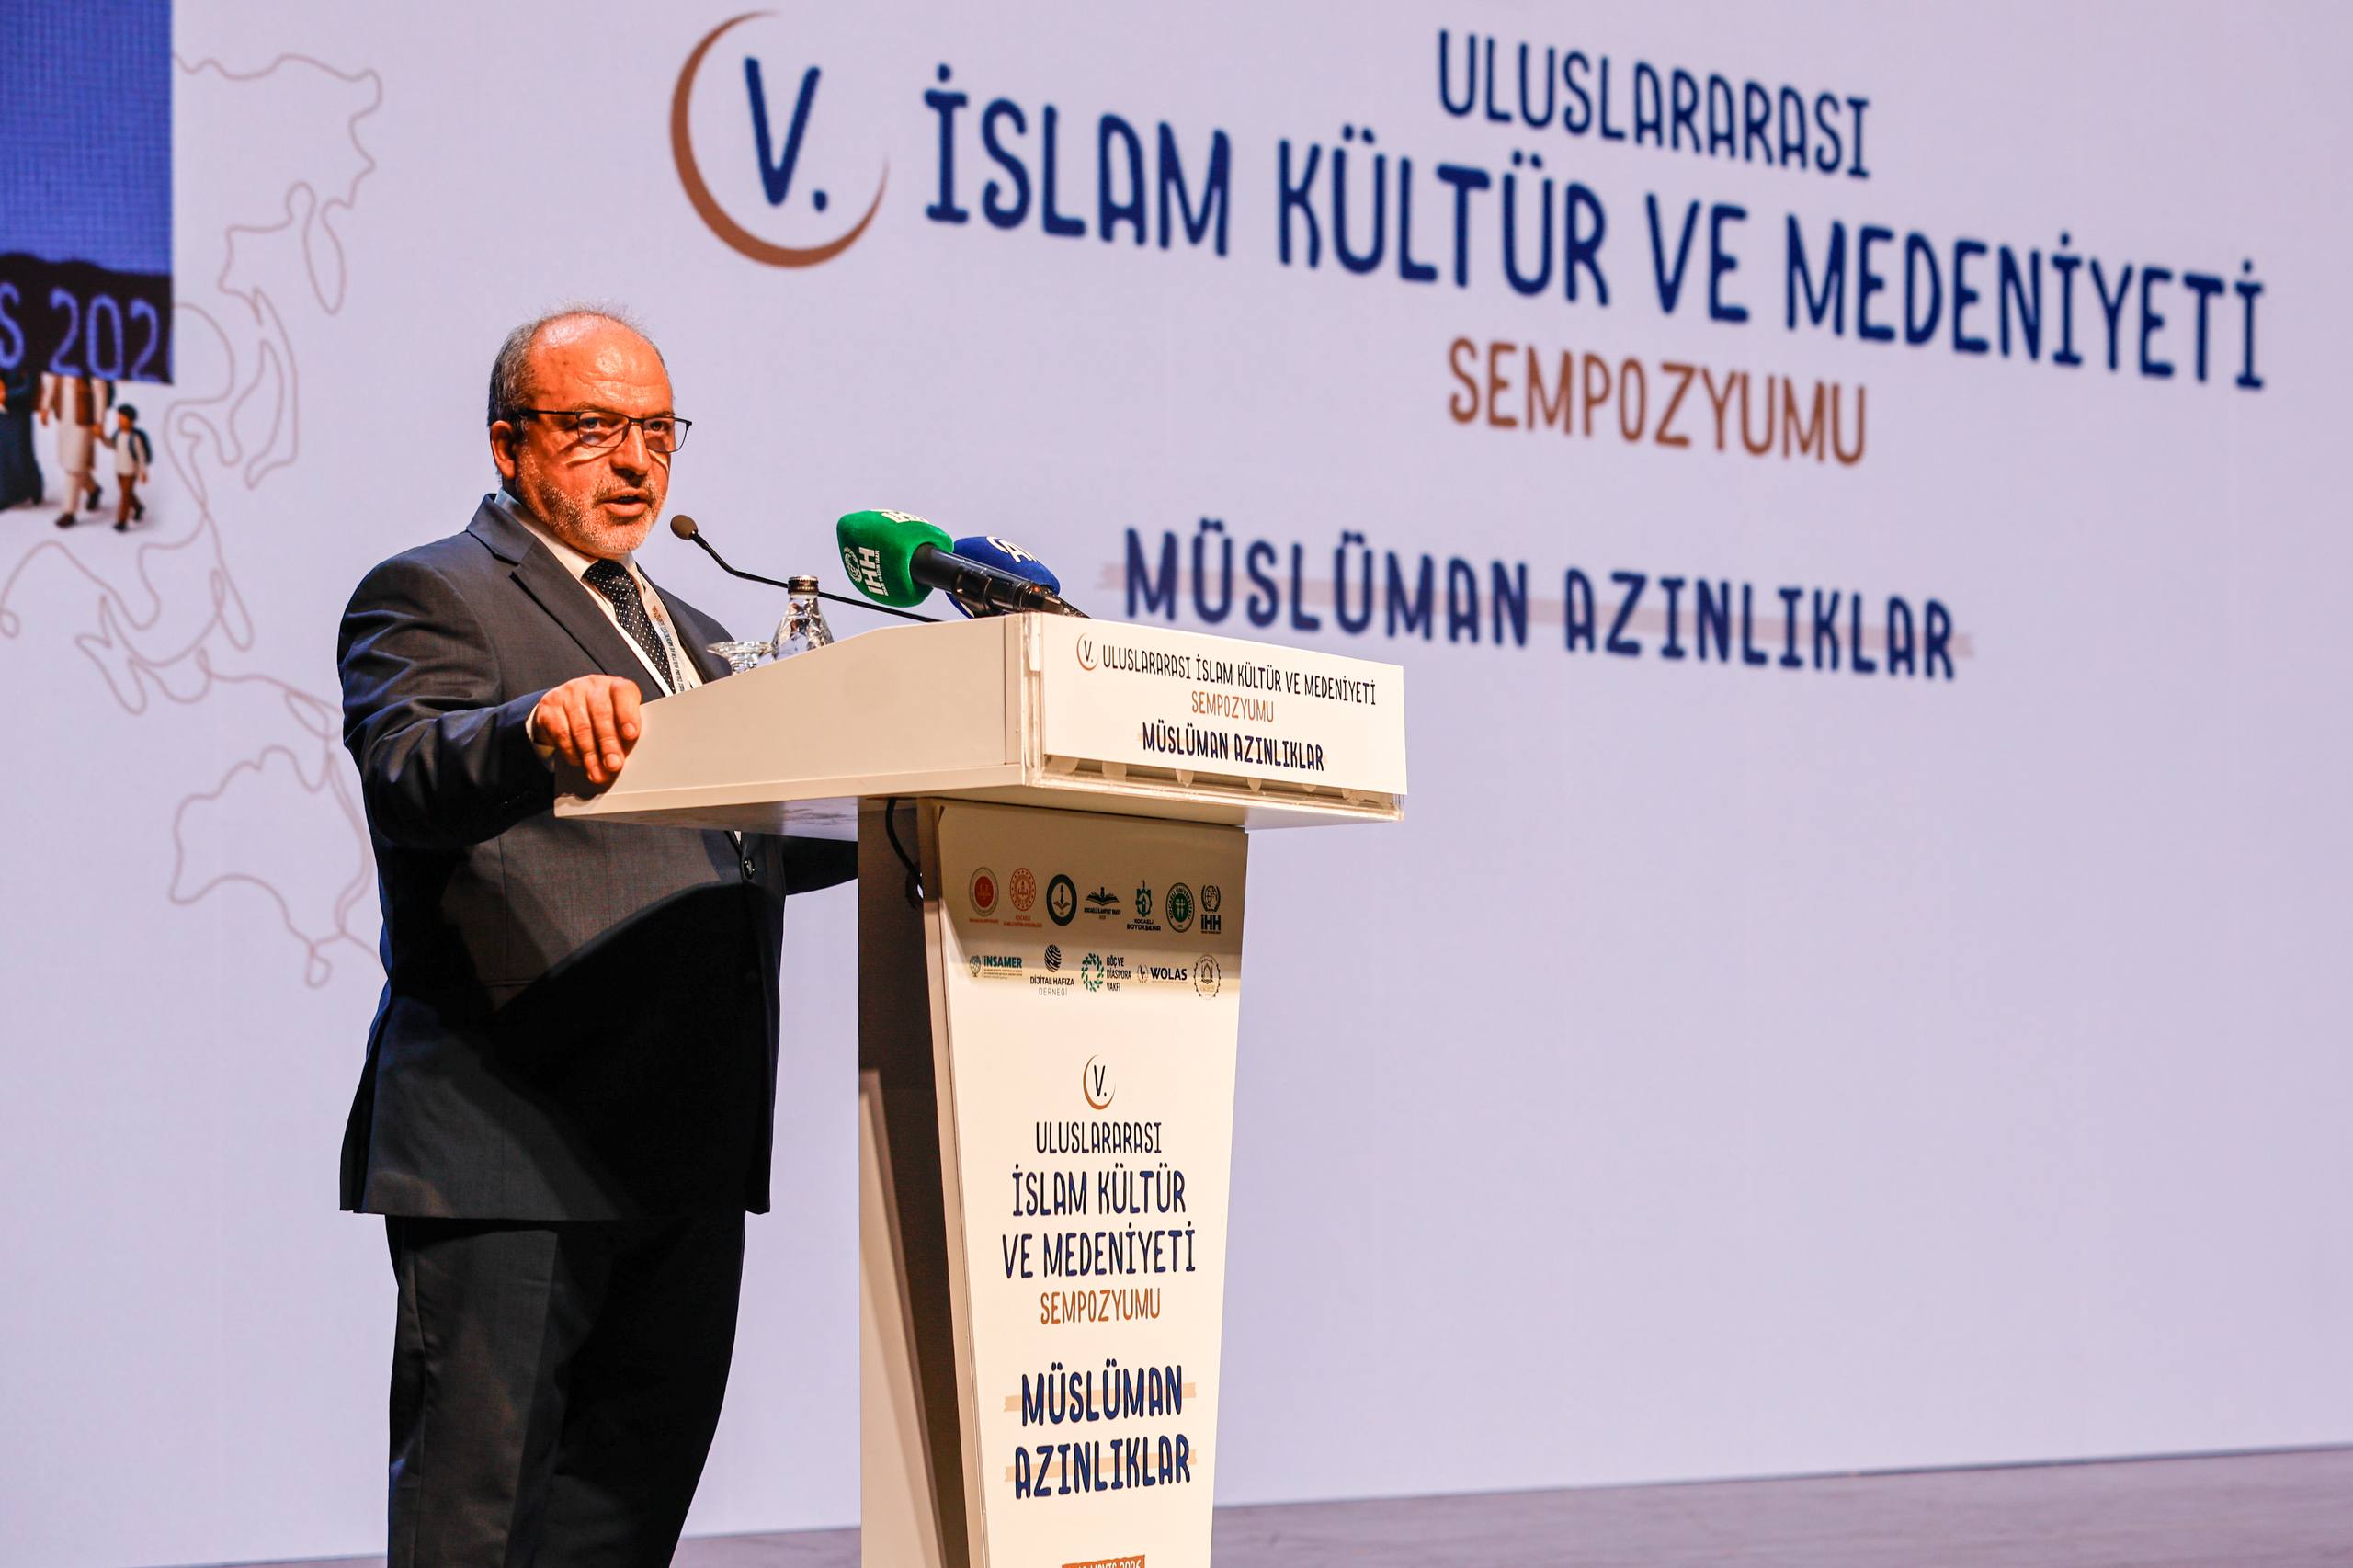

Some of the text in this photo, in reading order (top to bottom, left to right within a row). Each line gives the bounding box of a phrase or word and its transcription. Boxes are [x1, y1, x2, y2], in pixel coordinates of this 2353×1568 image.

[1437, 28, 1871, 181] ULUSLARARASI
[743, 55, 2266, 392] V. İSLAM KÜLTÜR VE MEDENİYETİ
[1448, 336, 1866, 467] SEMPOZYUMU
[1123, 516, 1956, 682] MÜSLÜMAN AZINLIKLAR
[1084, 640, 1376, 706] V. ULUSLARARASI İSLAM KÜLTÜR VE MEDENİYETİ
[1191, 690, 1274, 723] SEMPOZYUMU
[1142, 718, 1324, 772] MÜSLÜMAN AZINLIKLAR
[1053, 977, 1074, 986] HAFIZA
[1106, 954, 1125, 968] GÖÇ VE
[1106, 968, 1131, 980] DİASPORA
[1106, 982, 1121, 992] VAKFI
[1150, 967, 1188, 981] WOLAS
[1093, 1064, 1108, 1097] V.
[1035, 1120, 1163, 1154] ULUSLARARASI
[1011, 1161, 1187, 1218] İSLAM KÜLTÜR
[1002, 1220, 1196, 1280] VE MEDENİYETİ
[1040, 1287, 1161, 1325] SEMPOZYUMU
[1021, 1358, 1183, 1428] MÜSLÜMAN
[1014, 1433, 1191, 1501] AZINLIKLAR
